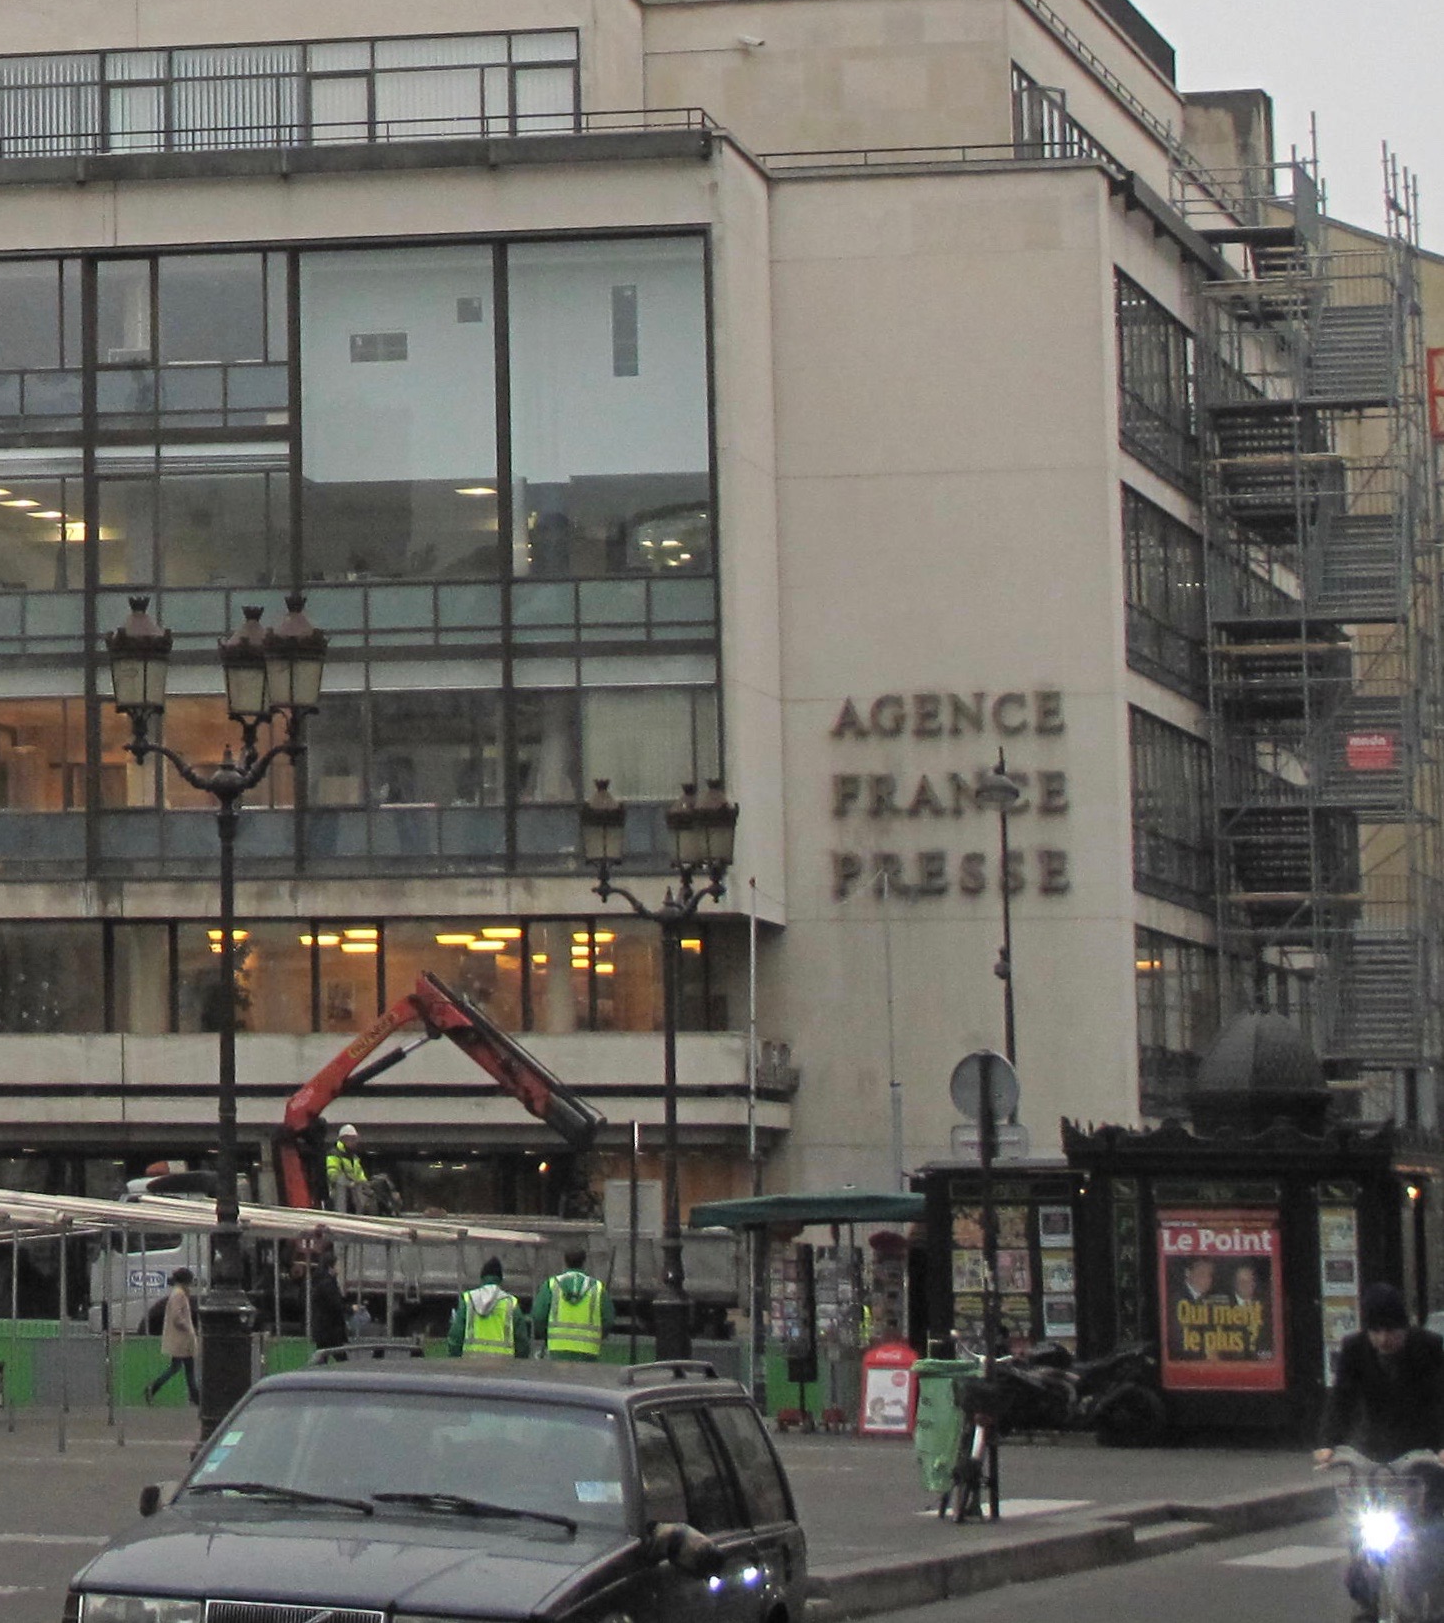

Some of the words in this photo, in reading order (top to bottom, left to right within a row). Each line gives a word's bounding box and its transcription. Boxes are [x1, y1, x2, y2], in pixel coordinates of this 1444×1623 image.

[831, 691, 1066, 738] AGENCE
[831, 850, 1070, 900] PRESSE
[1161, 1228, 1193, 1252] Le
[1197, 1227, 1272, 1252] Point
[1177, 1299, 1209, 1325] Qui
[1204, 1325, 1245, 1360] plus
